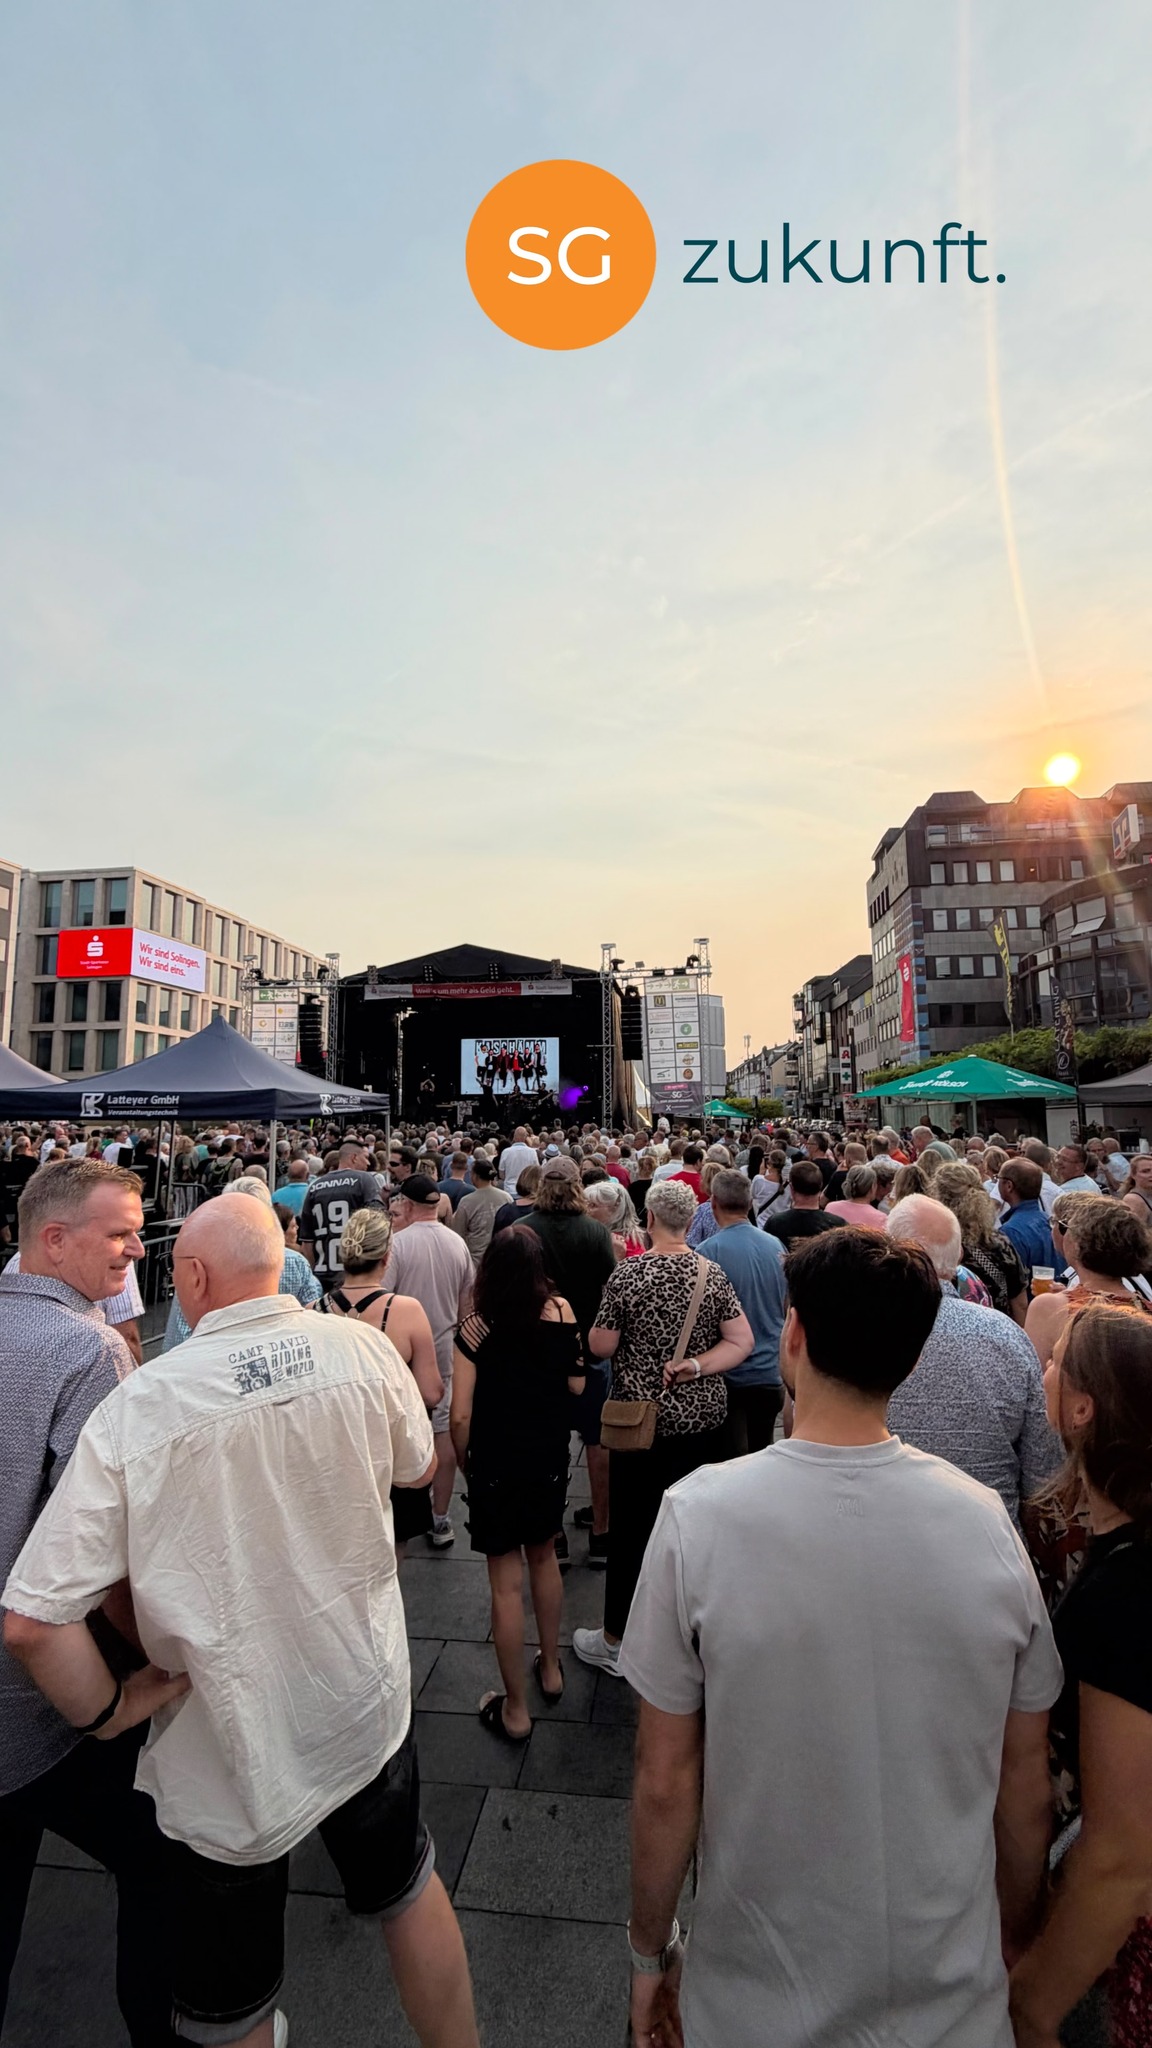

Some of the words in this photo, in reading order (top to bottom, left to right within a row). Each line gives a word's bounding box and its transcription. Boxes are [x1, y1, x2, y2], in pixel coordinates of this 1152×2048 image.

[138, 955, 153, 967] Wir
[153, 960, 169, 972] sind
[170, 965, 186, 977] eins.
[139, 942, 153, 954] Wir
[154, 947, 169, 959] sind
[170, 951, 201, 969] Solingen.
[449, 987, 468, 995] mehr
[480, 985, 496, 994] Geld
[107, 1095, 148, 1106] Latteyer
[150, 1095, 180, 1105] GmbH
[107, 1109, 178, 1117] Veranstaltungstechnik
[312, 1200, 349, 1236] 19
[228, 1344, 264, 1364] CAMP
[269, 1335, 309, 1352] DAVID
[271, 1345, 312, 1369] RIDING
